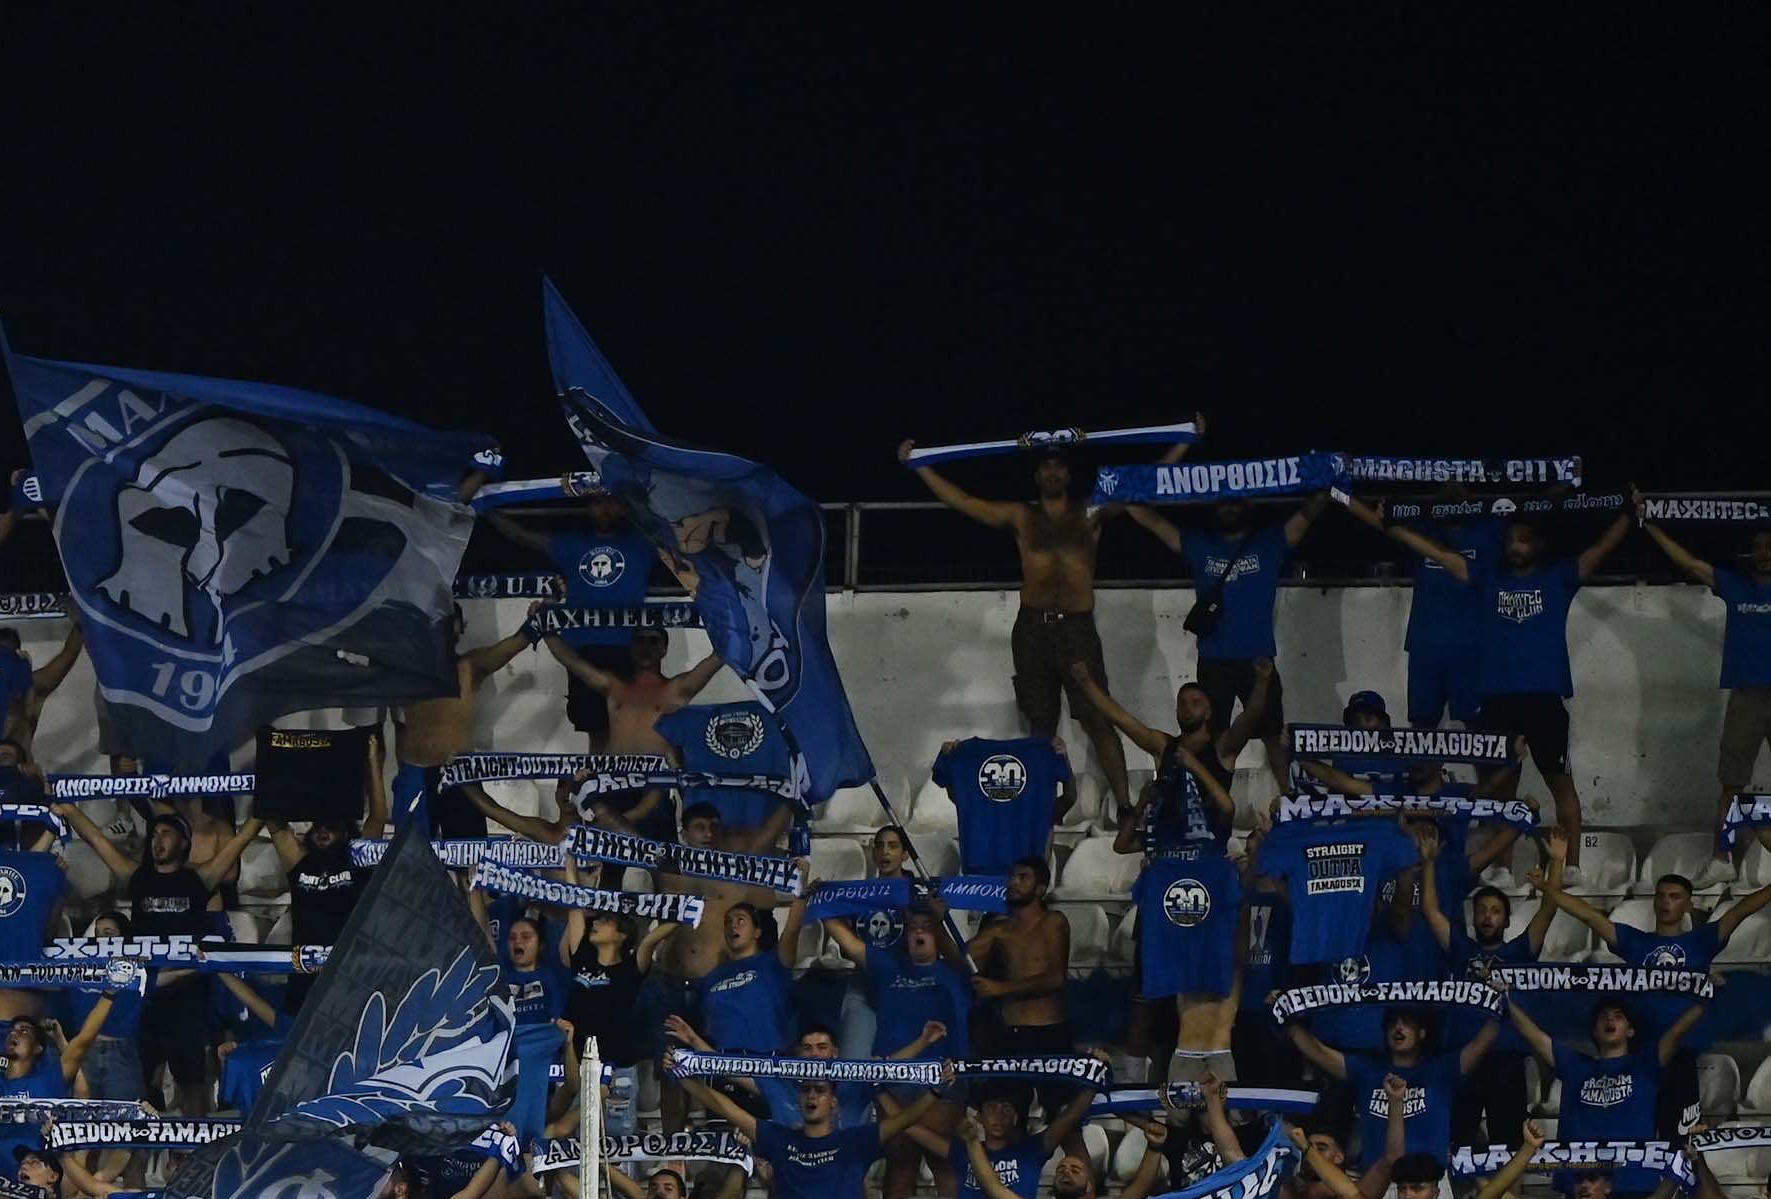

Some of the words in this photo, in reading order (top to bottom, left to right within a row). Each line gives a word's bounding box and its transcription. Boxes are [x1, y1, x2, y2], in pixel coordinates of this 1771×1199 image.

[1155, 455, 1301, 496] ΑΝΟΡΘΩΣΙΣ
[1644, 493, 1760, 516] MAXHTEC
[1294, 728, 1380, 753] FREEDOM
[1392, 731, 1508, 759] FAMAGUSTA
[1306, 844, 1364, 861] STRAIGHT
[1585, 834, 1598, 848] B2
[1309, 877, 1362, 893] FAMAGUSTA
[1587, 968, 1716, 1000] FAMAGUSTA
